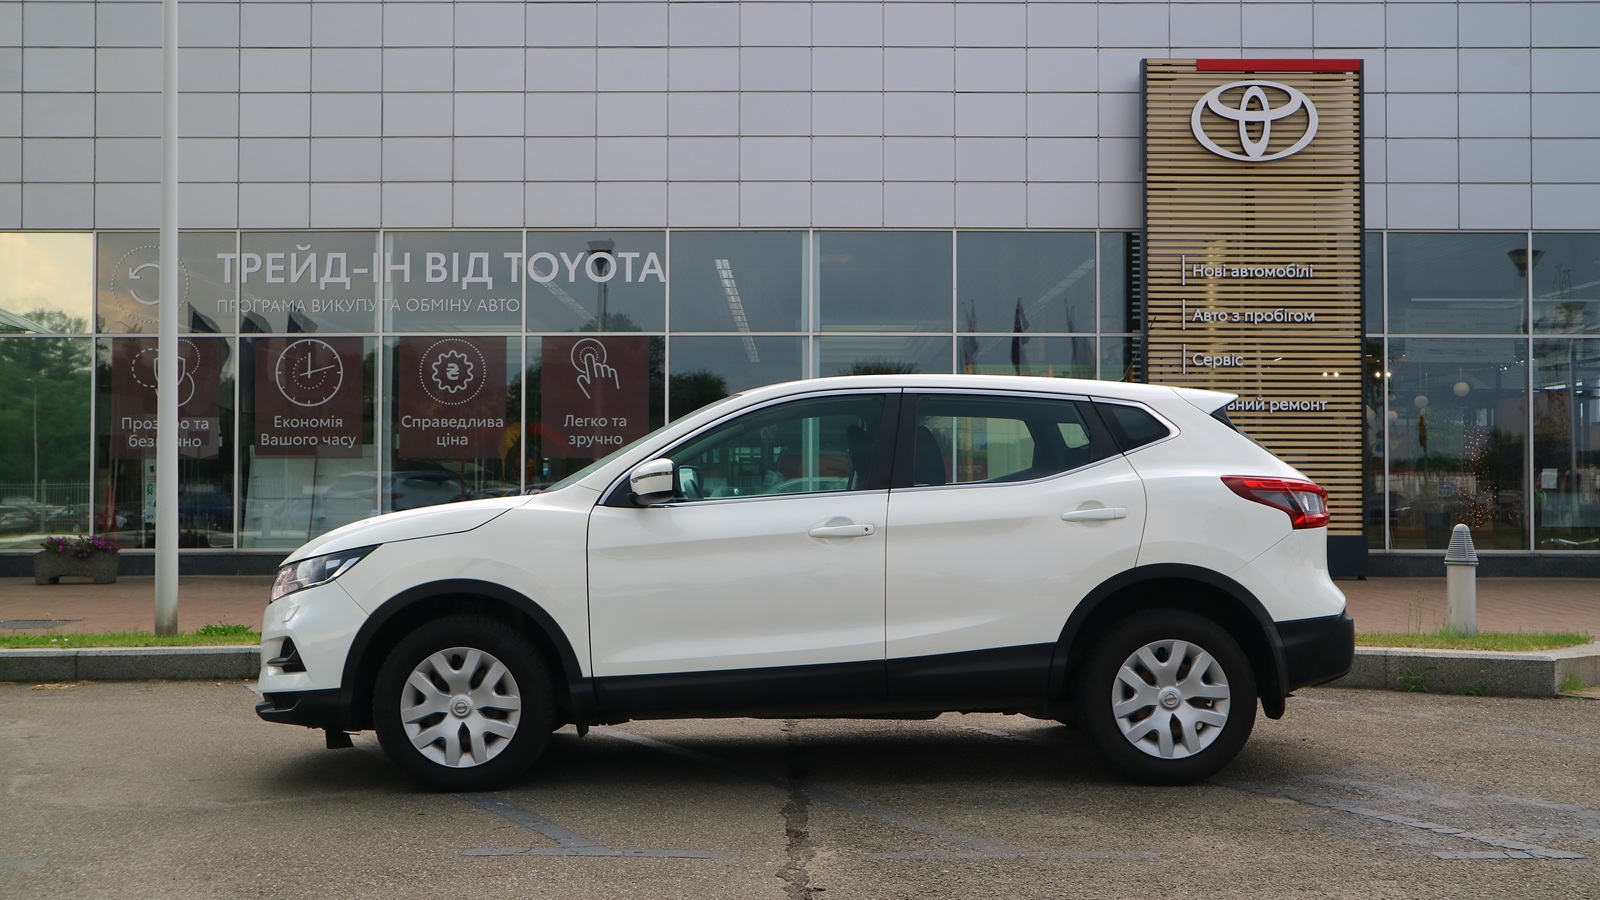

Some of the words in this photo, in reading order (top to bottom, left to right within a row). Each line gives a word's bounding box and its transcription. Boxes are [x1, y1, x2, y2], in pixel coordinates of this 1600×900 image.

[216, 244, 411, 291] ТРЕЙД-ІН
[425, 251, 494, 290] ВІД
[503, 251, 667, 284] TOYOTA
[1192, 264, 1227, 278] Нові
[1231, 263, 1314, 278] автомобілі
[217, 299, 307, 313] ПРОГРАМА
[311, 298, 378, 312] ВИКУПУ
[382, 298, 401, 312] ТА
[405, 298, 473, 312] ОБМІНУ
[476, 298, 521, 312] АВТО
[1191, 308, 1229, 322] Авто
[1231, 310, 1240, 322] з
[1244, 308, 1316, 325] пробігом
[1192, 353, 1245, 369] Сервіс
[1269, 400, 1328, 414] ремонт
[121, 417, 190, 432] Прозо
[193, 420, 209, 430] та
[273, 415, 344, 428] Економія
[401, 415, 504, 431] Справедлива
[563, 415, 608, 428] Легко
[610, 416, 627, 428] та
[260, 434, 319, 447] Вашого
[322, 435, 357, 449] часу
[436, 433, 469, 447] ціна
[568, 433, 623, 448] зручно
